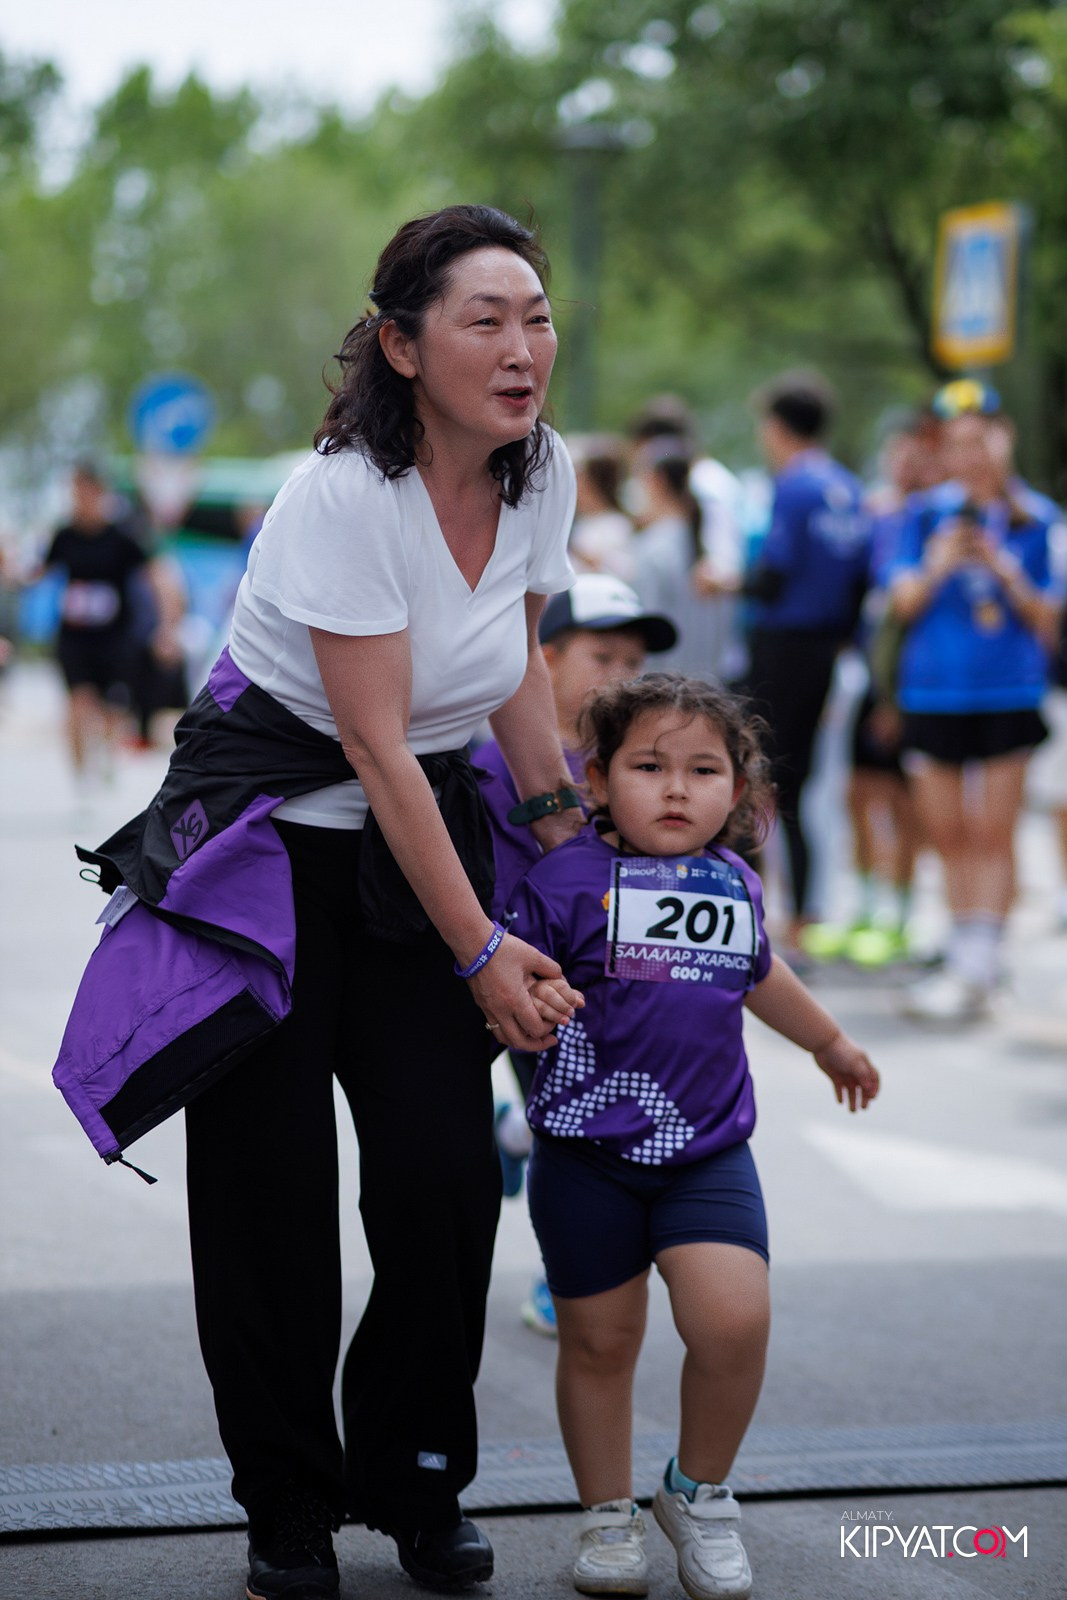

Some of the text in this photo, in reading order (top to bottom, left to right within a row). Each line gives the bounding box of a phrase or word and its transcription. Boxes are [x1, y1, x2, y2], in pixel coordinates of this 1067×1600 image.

[645, 896, 735, 945] 201
[487, 934, 501, 953] 2025
[670, 966, 701, 981] 600
